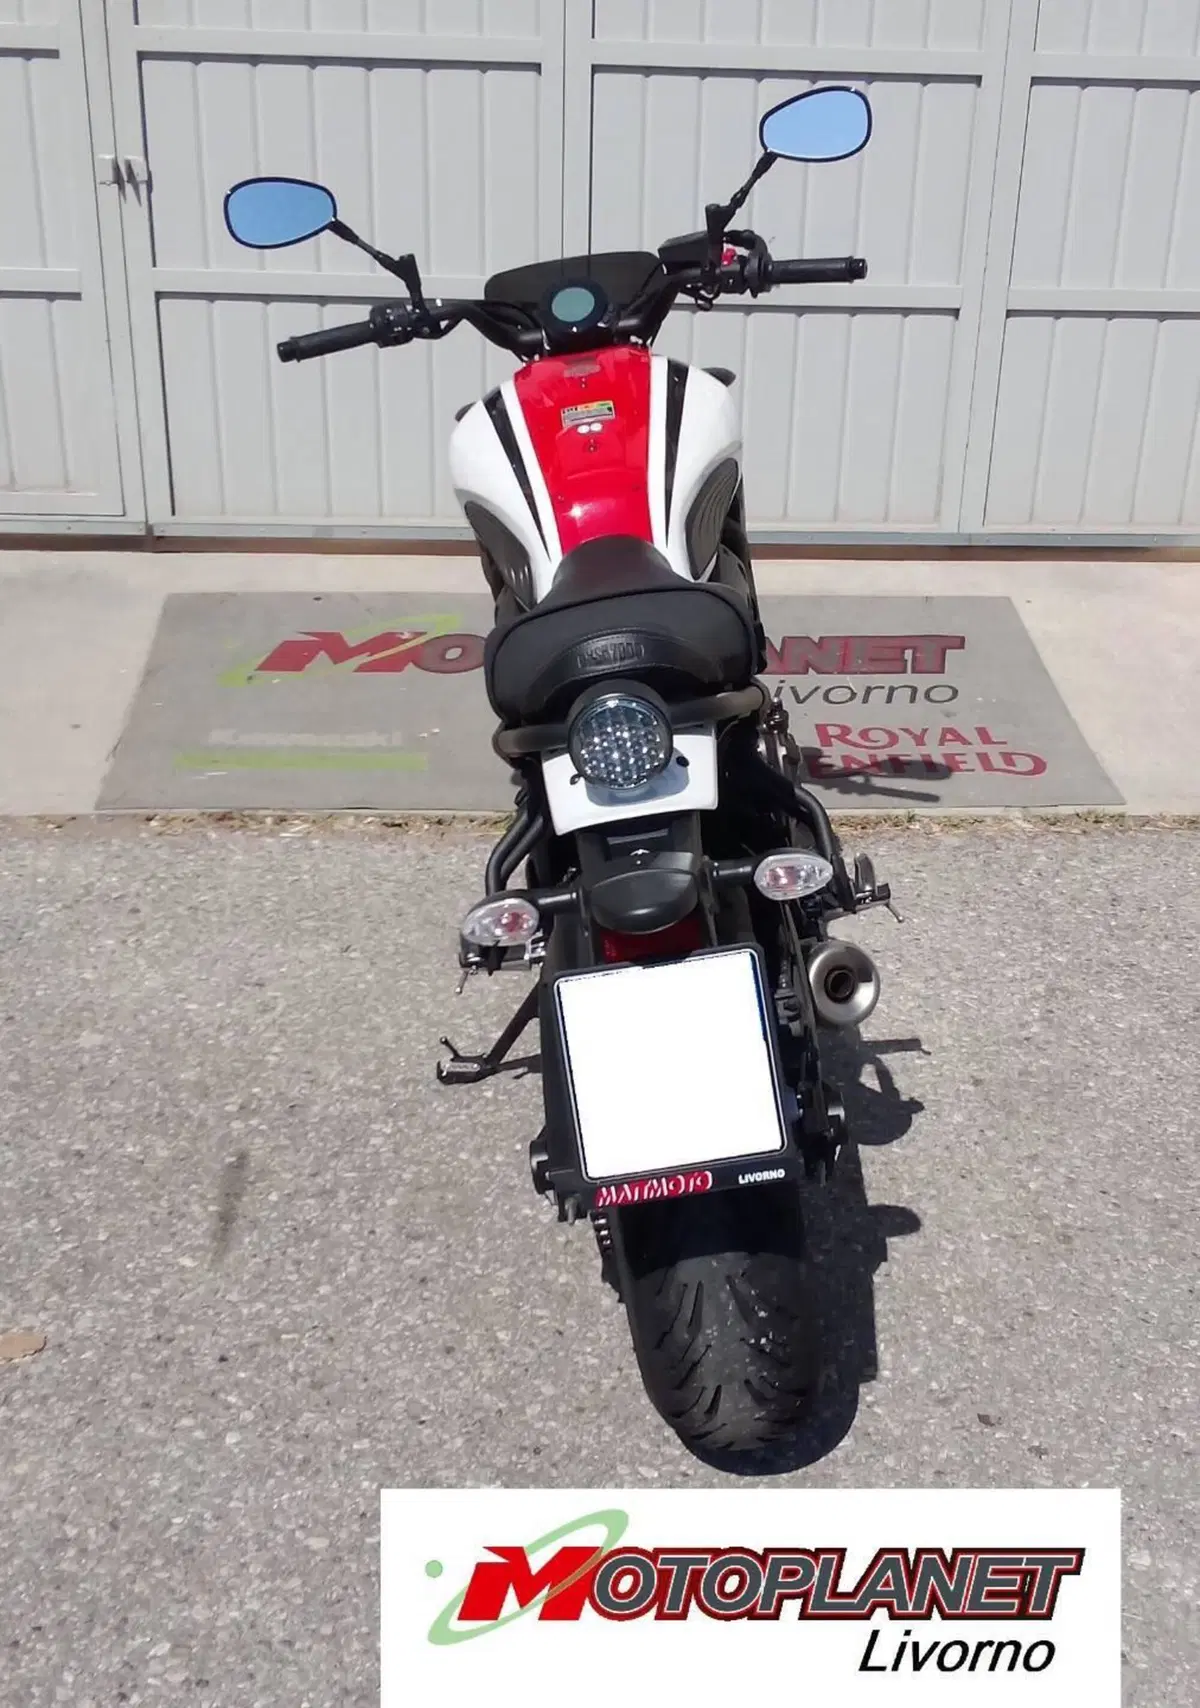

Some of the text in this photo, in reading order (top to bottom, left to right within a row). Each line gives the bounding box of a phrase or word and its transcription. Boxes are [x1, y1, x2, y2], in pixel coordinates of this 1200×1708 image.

[770, 679, 959, 705] ivorno
[815, 722, 1008, 750] ROYAL
[805, 751, 1048, 779] ENFIELD
[738, 1168, 786, 1185] LIVORNO
